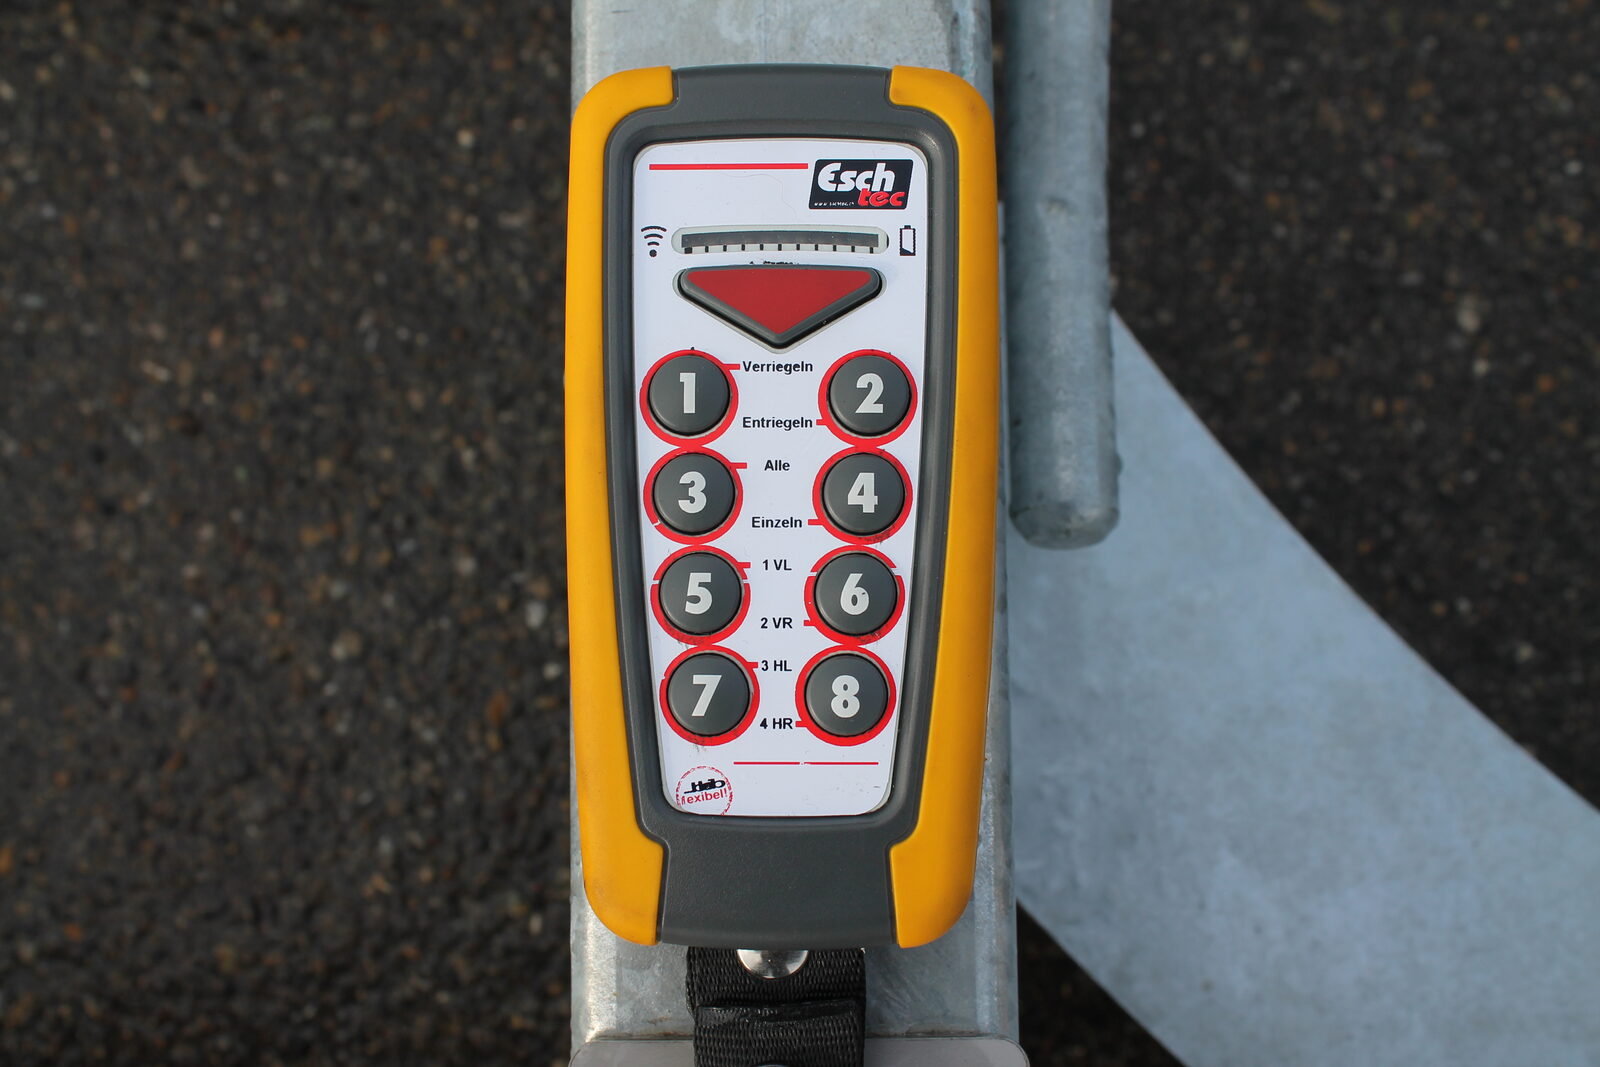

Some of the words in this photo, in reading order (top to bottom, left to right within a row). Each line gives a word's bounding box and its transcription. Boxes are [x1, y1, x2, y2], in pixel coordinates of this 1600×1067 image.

[818, 163, 895, 192] Esch
[858, 188, 905, 207] tec
[742, 361, 813, 375] Verriegeln
[679, 372, 696, 414] 1
[855, 372, 884, 414] 2
[742, 416, 813, 431] Entriegeln
[764, 459, 791, 471] Alle
[678, 471, 707, 514] 3
[847, 472, 878, 513] 4
[751, 516, 803, 529] Einzeln
[762, 560, 769, 571] 1
[773, 560, 792, 571] VL
[684, 572, 713, 615] 5
[840, 573, 870, 616] 6
[760, 618, 769, 629] 2
[772, 618, 793, 629] VR
[761, 660, 769, 672] 3
[773, 660, 792, 672] HL
[691, 674, 722, 717] 7
[830, 675, 860, 718] 8
[759, 718, 768, 729] 4
[772, 718, 793, 729] HR
